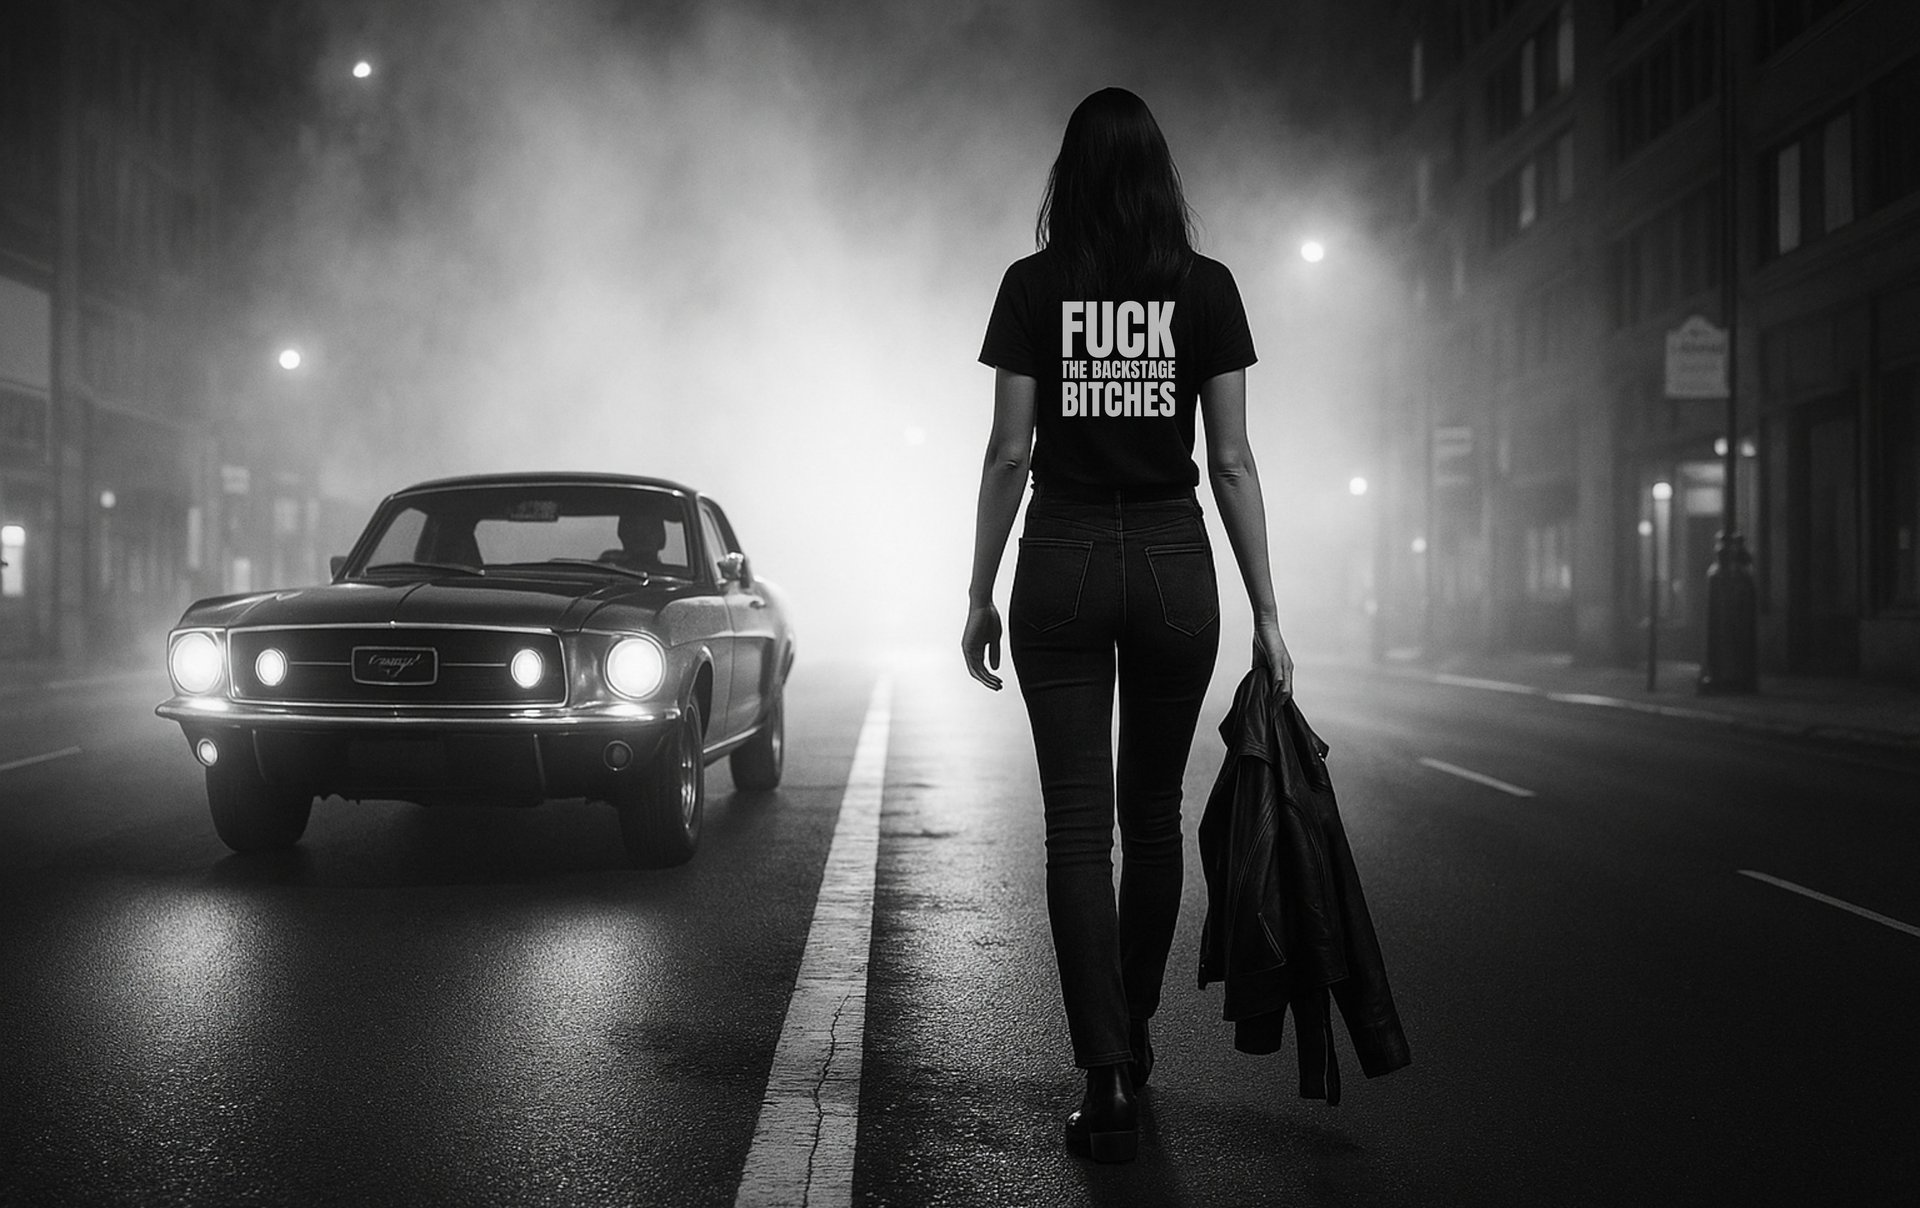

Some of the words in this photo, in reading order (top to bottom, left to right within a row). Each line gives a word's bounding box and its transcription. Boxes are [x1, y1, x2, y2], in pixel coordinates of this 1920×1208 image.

[1062, 300, 1176, 358] FUCK
[1062, 360, 1088, 379] THE
[1092, 360, 1176, 379] BACKSTAGE
[1062, 381, 1176, 418] BITCHES
